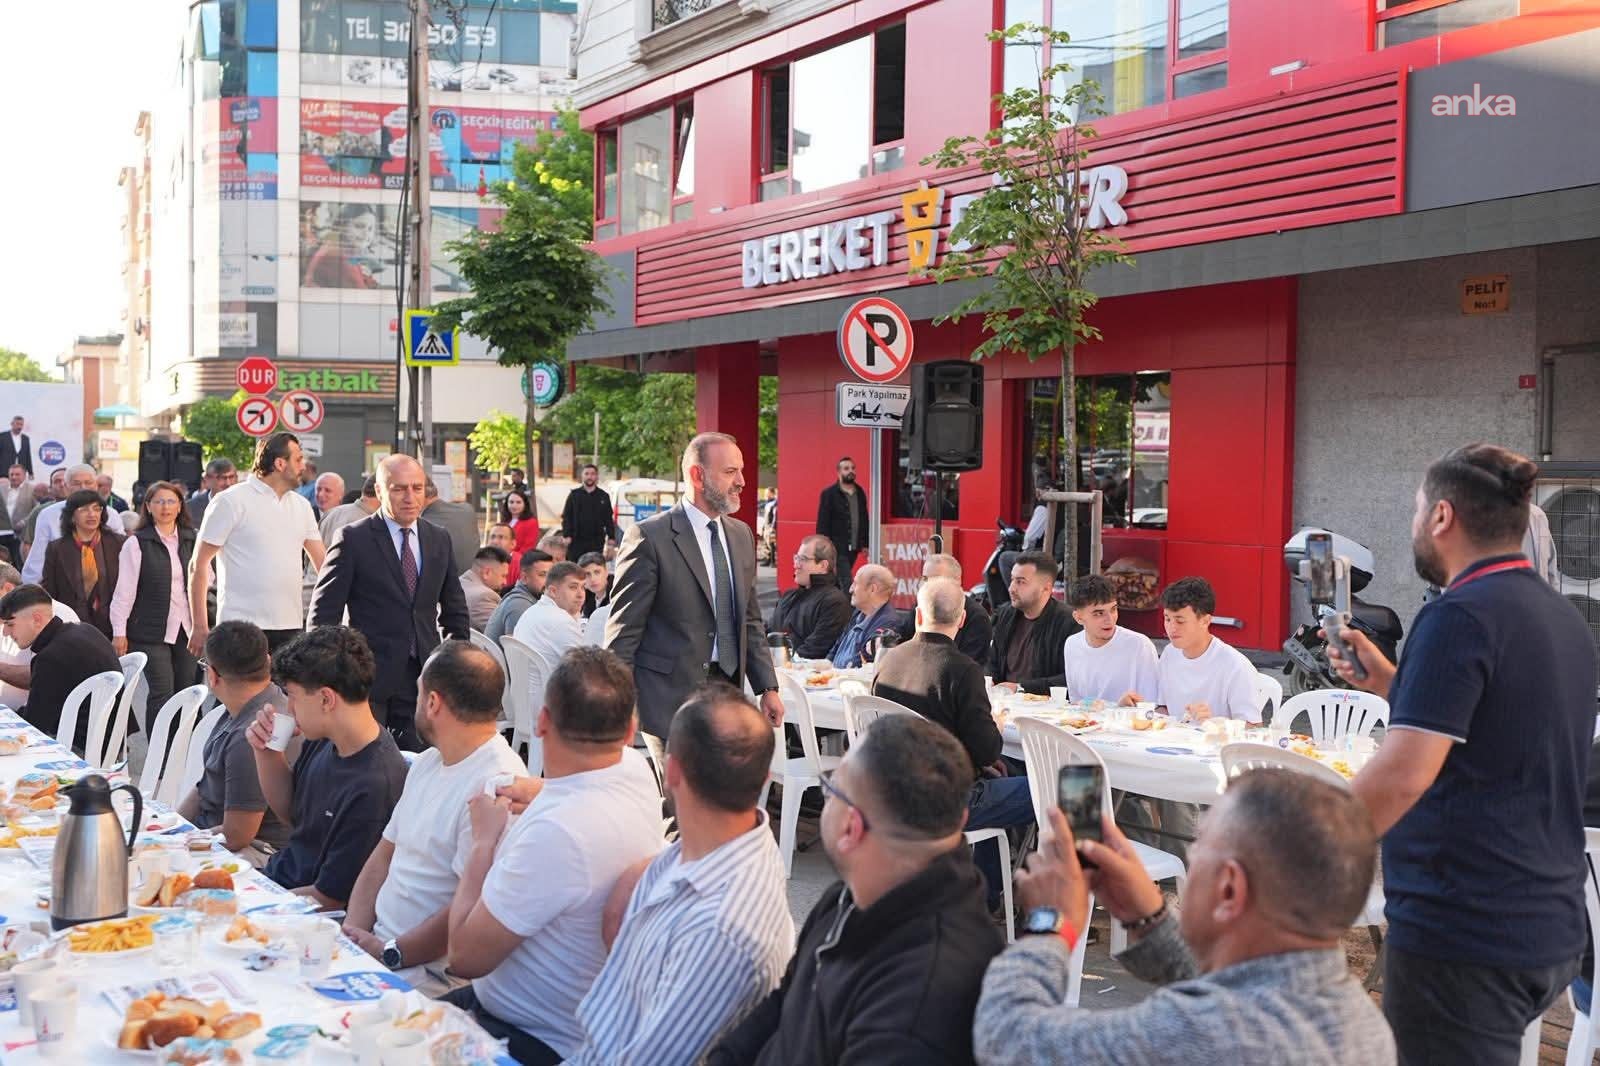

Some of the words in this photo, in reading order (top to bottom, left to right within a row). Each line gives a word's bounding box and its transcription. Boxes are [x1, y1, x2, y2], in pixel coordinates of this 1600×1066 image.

[346, 16, 379, 40] TEL.
[427, 24, 457, 46] 50
[465, 26, 497, 47] 53
[742, 211, 896, 288] BEREKET
[239, 369, 274, 385] DUR
[278, 368, 380, 391] tatbak
[847, 388, 866, 399] Park
[869, 389, 907, 401] Yapılmaz
[886, 543, 931, 561] TAKO
[892, 578, 922, 596] AK
